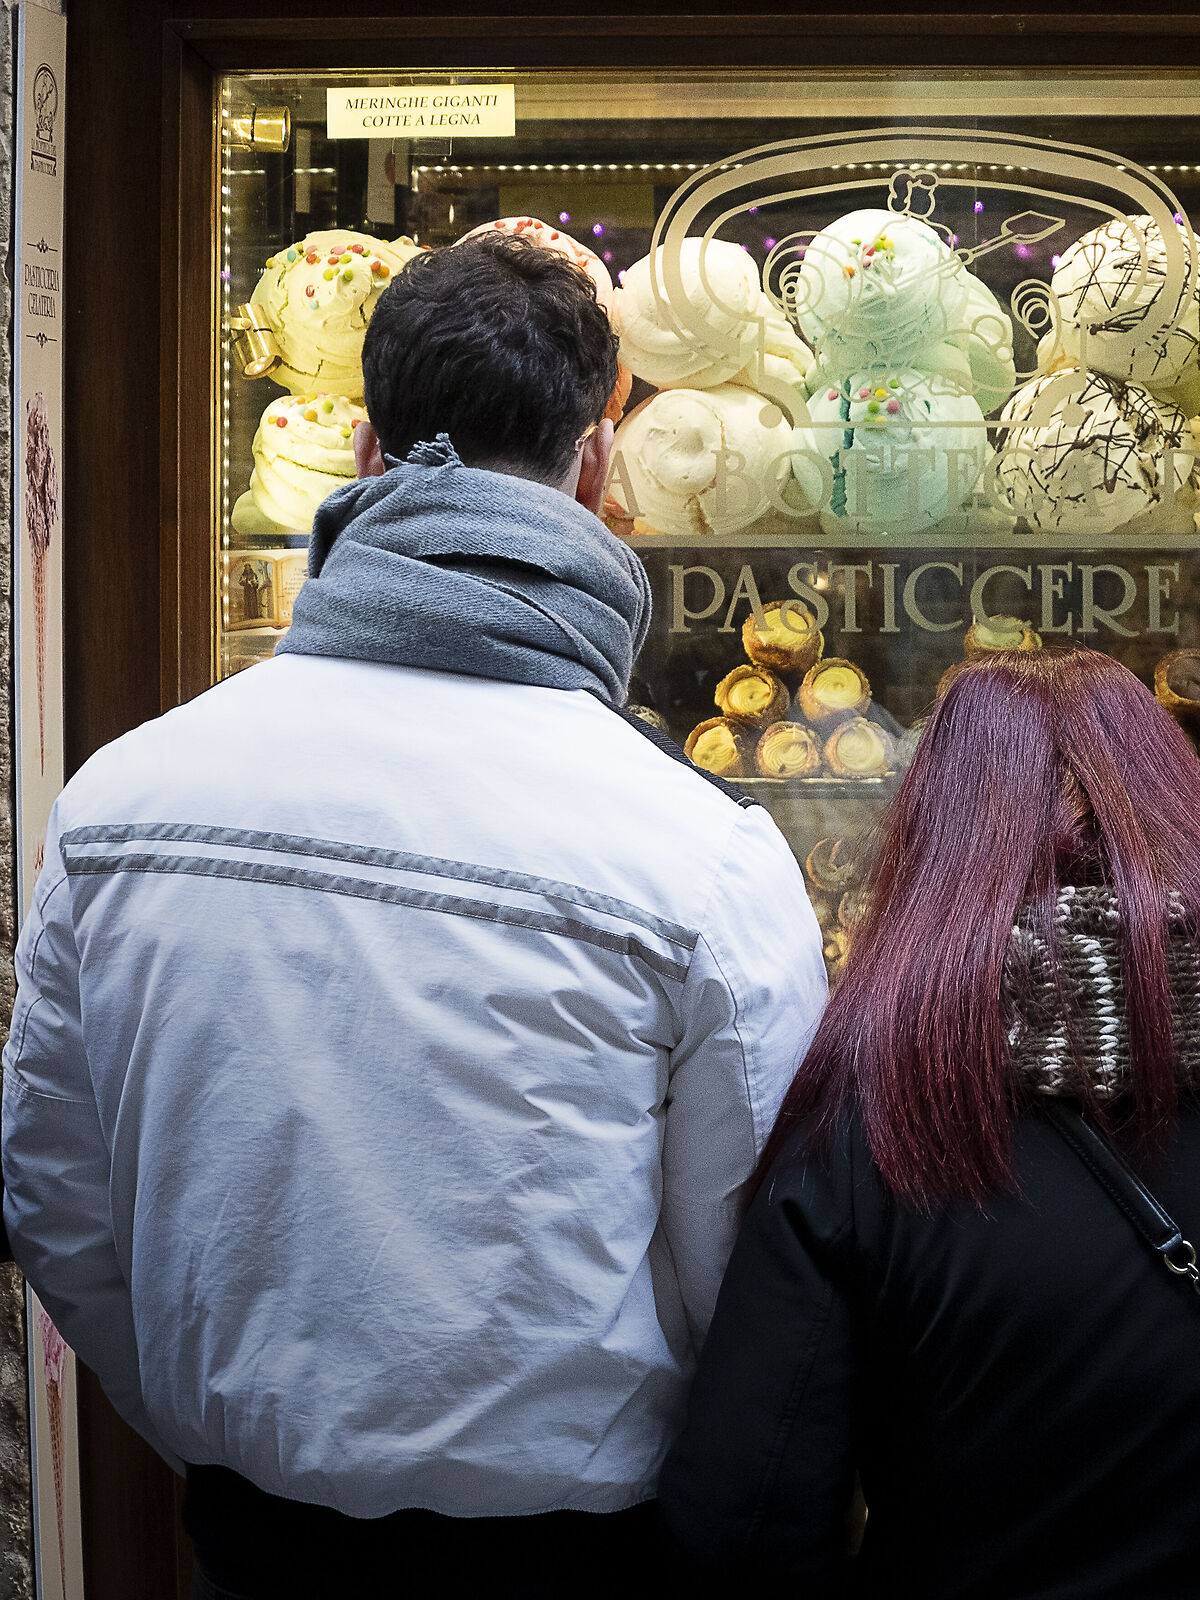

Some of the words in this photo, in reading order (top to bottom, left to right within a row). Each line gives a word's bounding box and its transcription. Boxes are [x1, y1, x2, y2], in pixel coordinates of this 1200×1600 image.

[345, 96, 429, 110] MERINGHE
[432, 95, 498, 108] GIGANTI
[362, 114, 411, 128] COTTE
[415, 114, 425, 126] A
[430, 113, 481, 126] LEGNA
[597, 449, 646, 518] A
[710, 447, 1106, 519] BOTTEGA
[668, 559, 1182, 638] PASTICCERE
